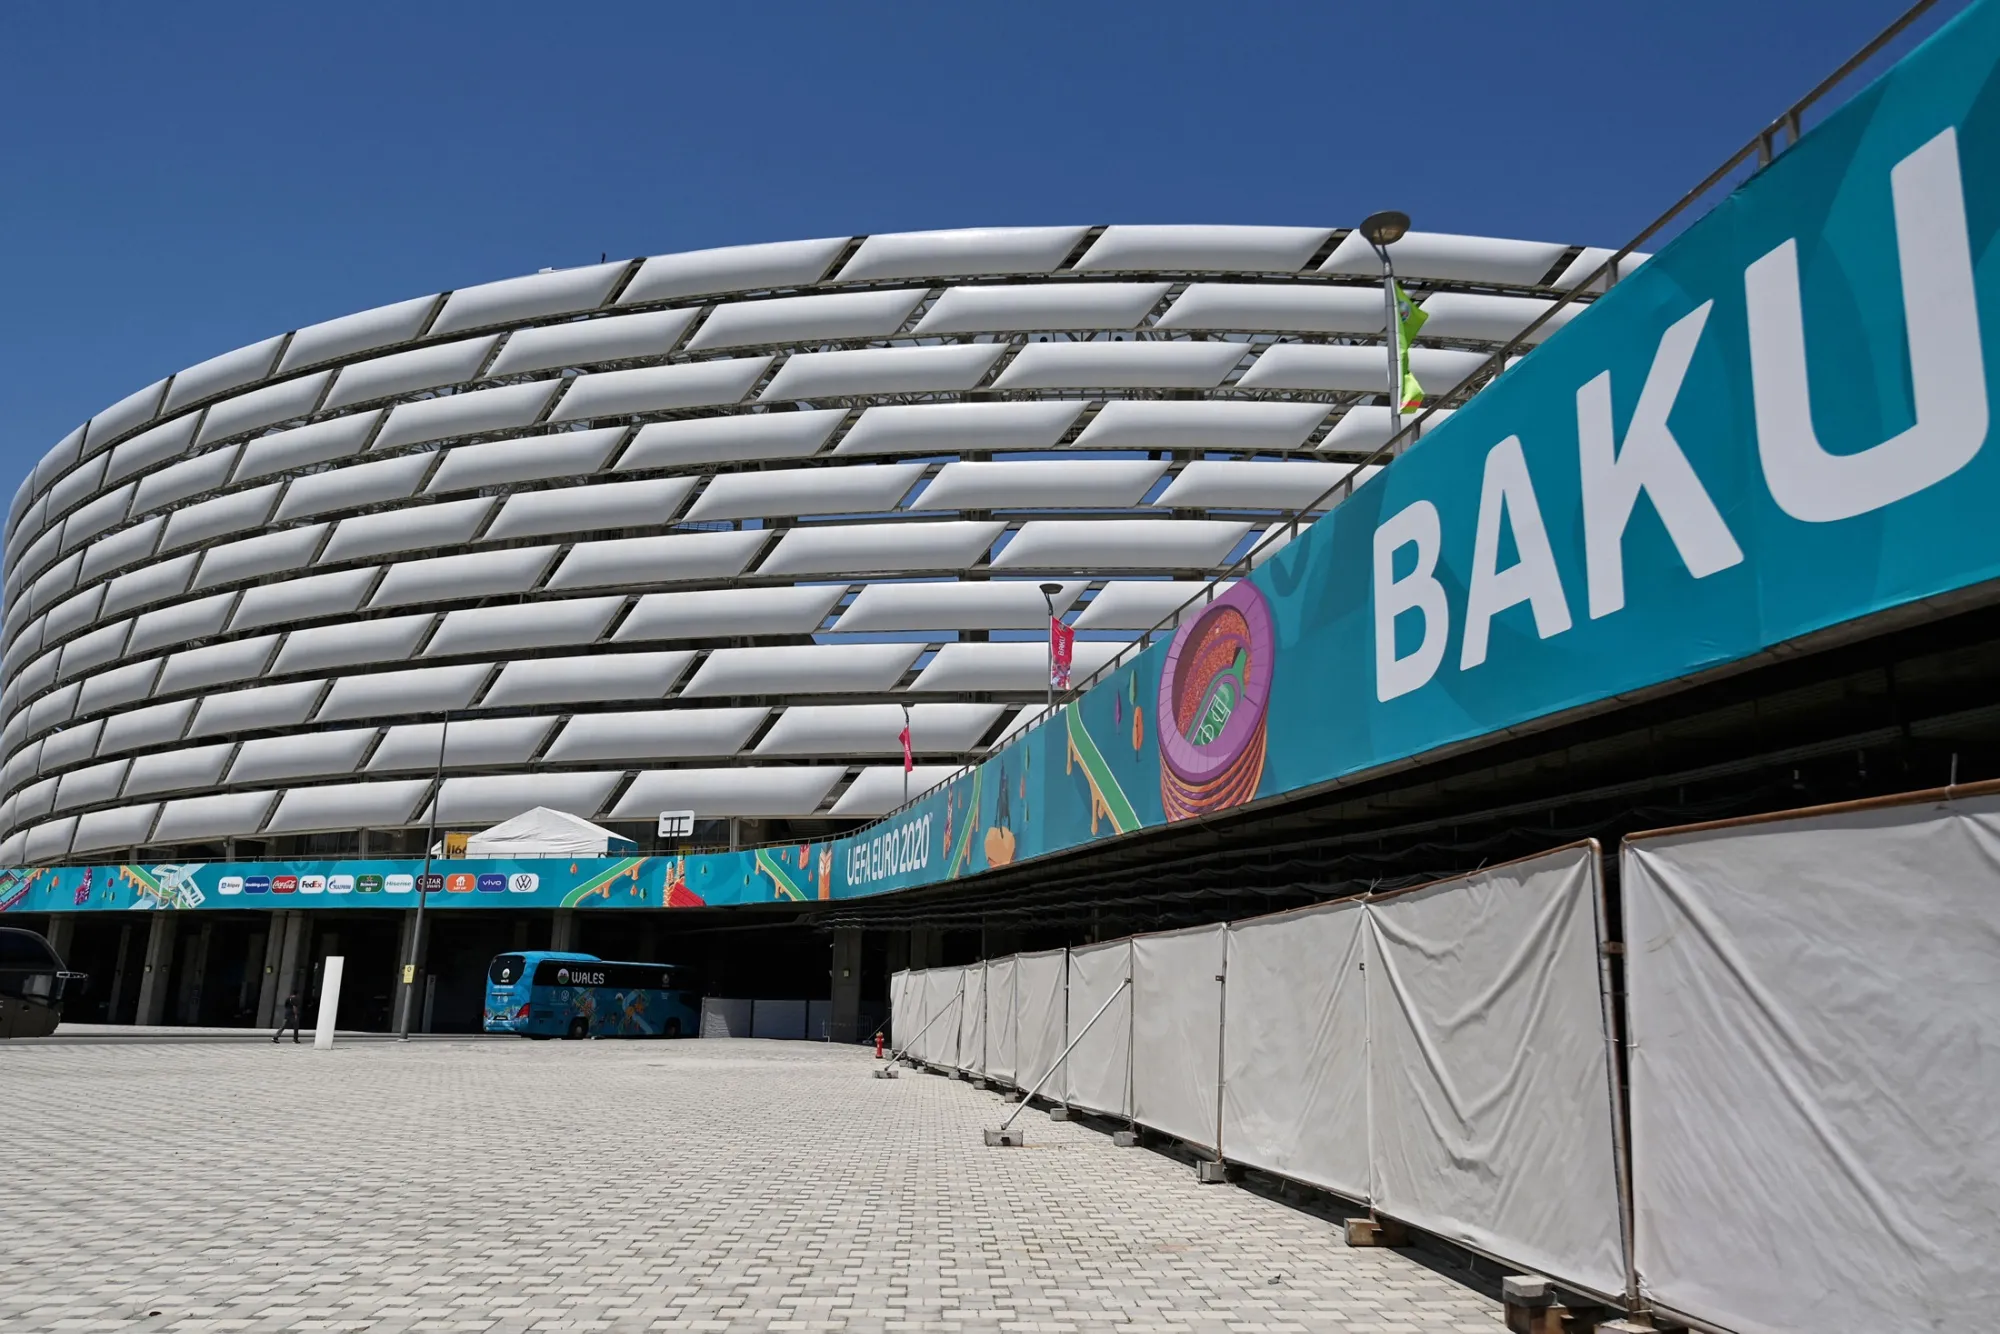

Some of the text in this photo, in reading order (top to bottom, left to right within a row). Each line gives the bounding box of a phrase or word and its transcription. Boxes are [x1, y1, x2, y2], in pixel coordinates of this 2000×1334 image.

[1373, 125, 1989, 702] BAKU
[1058, 636, 1066, 656] BAKU
[847, 814, 930, 886] UEFA EURO 2020
[301, 880, 323, 889] FedEx
[571, 971, 605, 985] WALES
